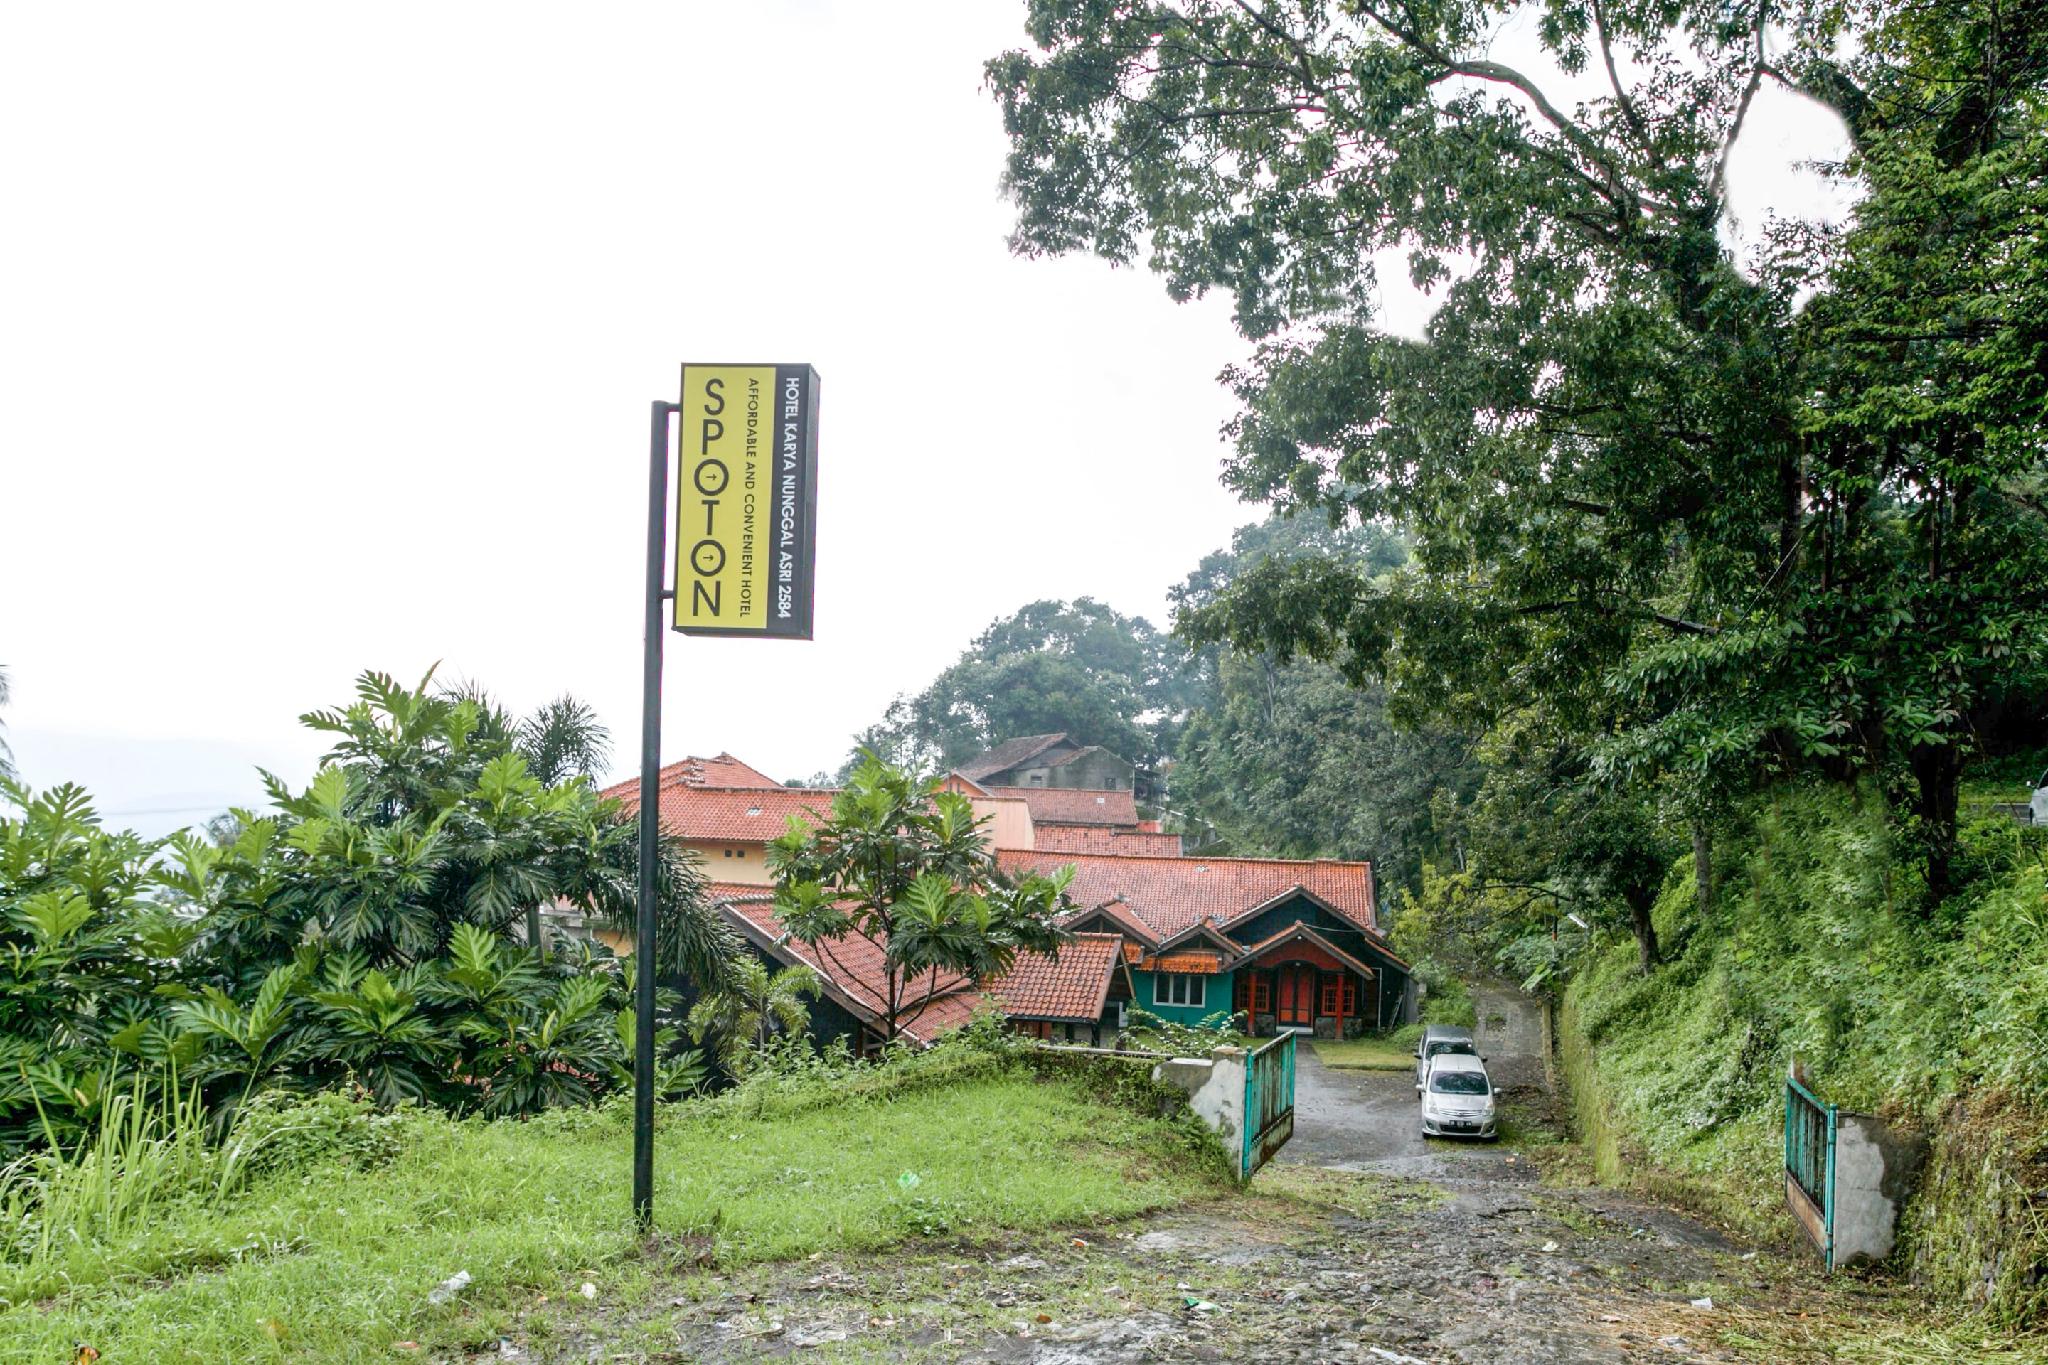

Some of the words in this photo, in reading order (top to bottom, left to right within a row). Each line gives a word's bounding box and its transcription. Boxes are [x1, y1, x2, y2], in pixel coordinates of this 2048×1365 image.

[747, 378, 759, 457] AFFORDABLE
[786, 377, 799, 419] HOTEL
[783, 423, 797, 471] KARYA
[745, 462, 756, 490] AND
[781, 475, 795, 547] NUNGGAL
[743, 494, 754, 576] CONVENIENT
[779, 551, 792, 583] ASRI
[740, 580, 751, 617] HOTEL
[778, 585, 791, 618] 2584
